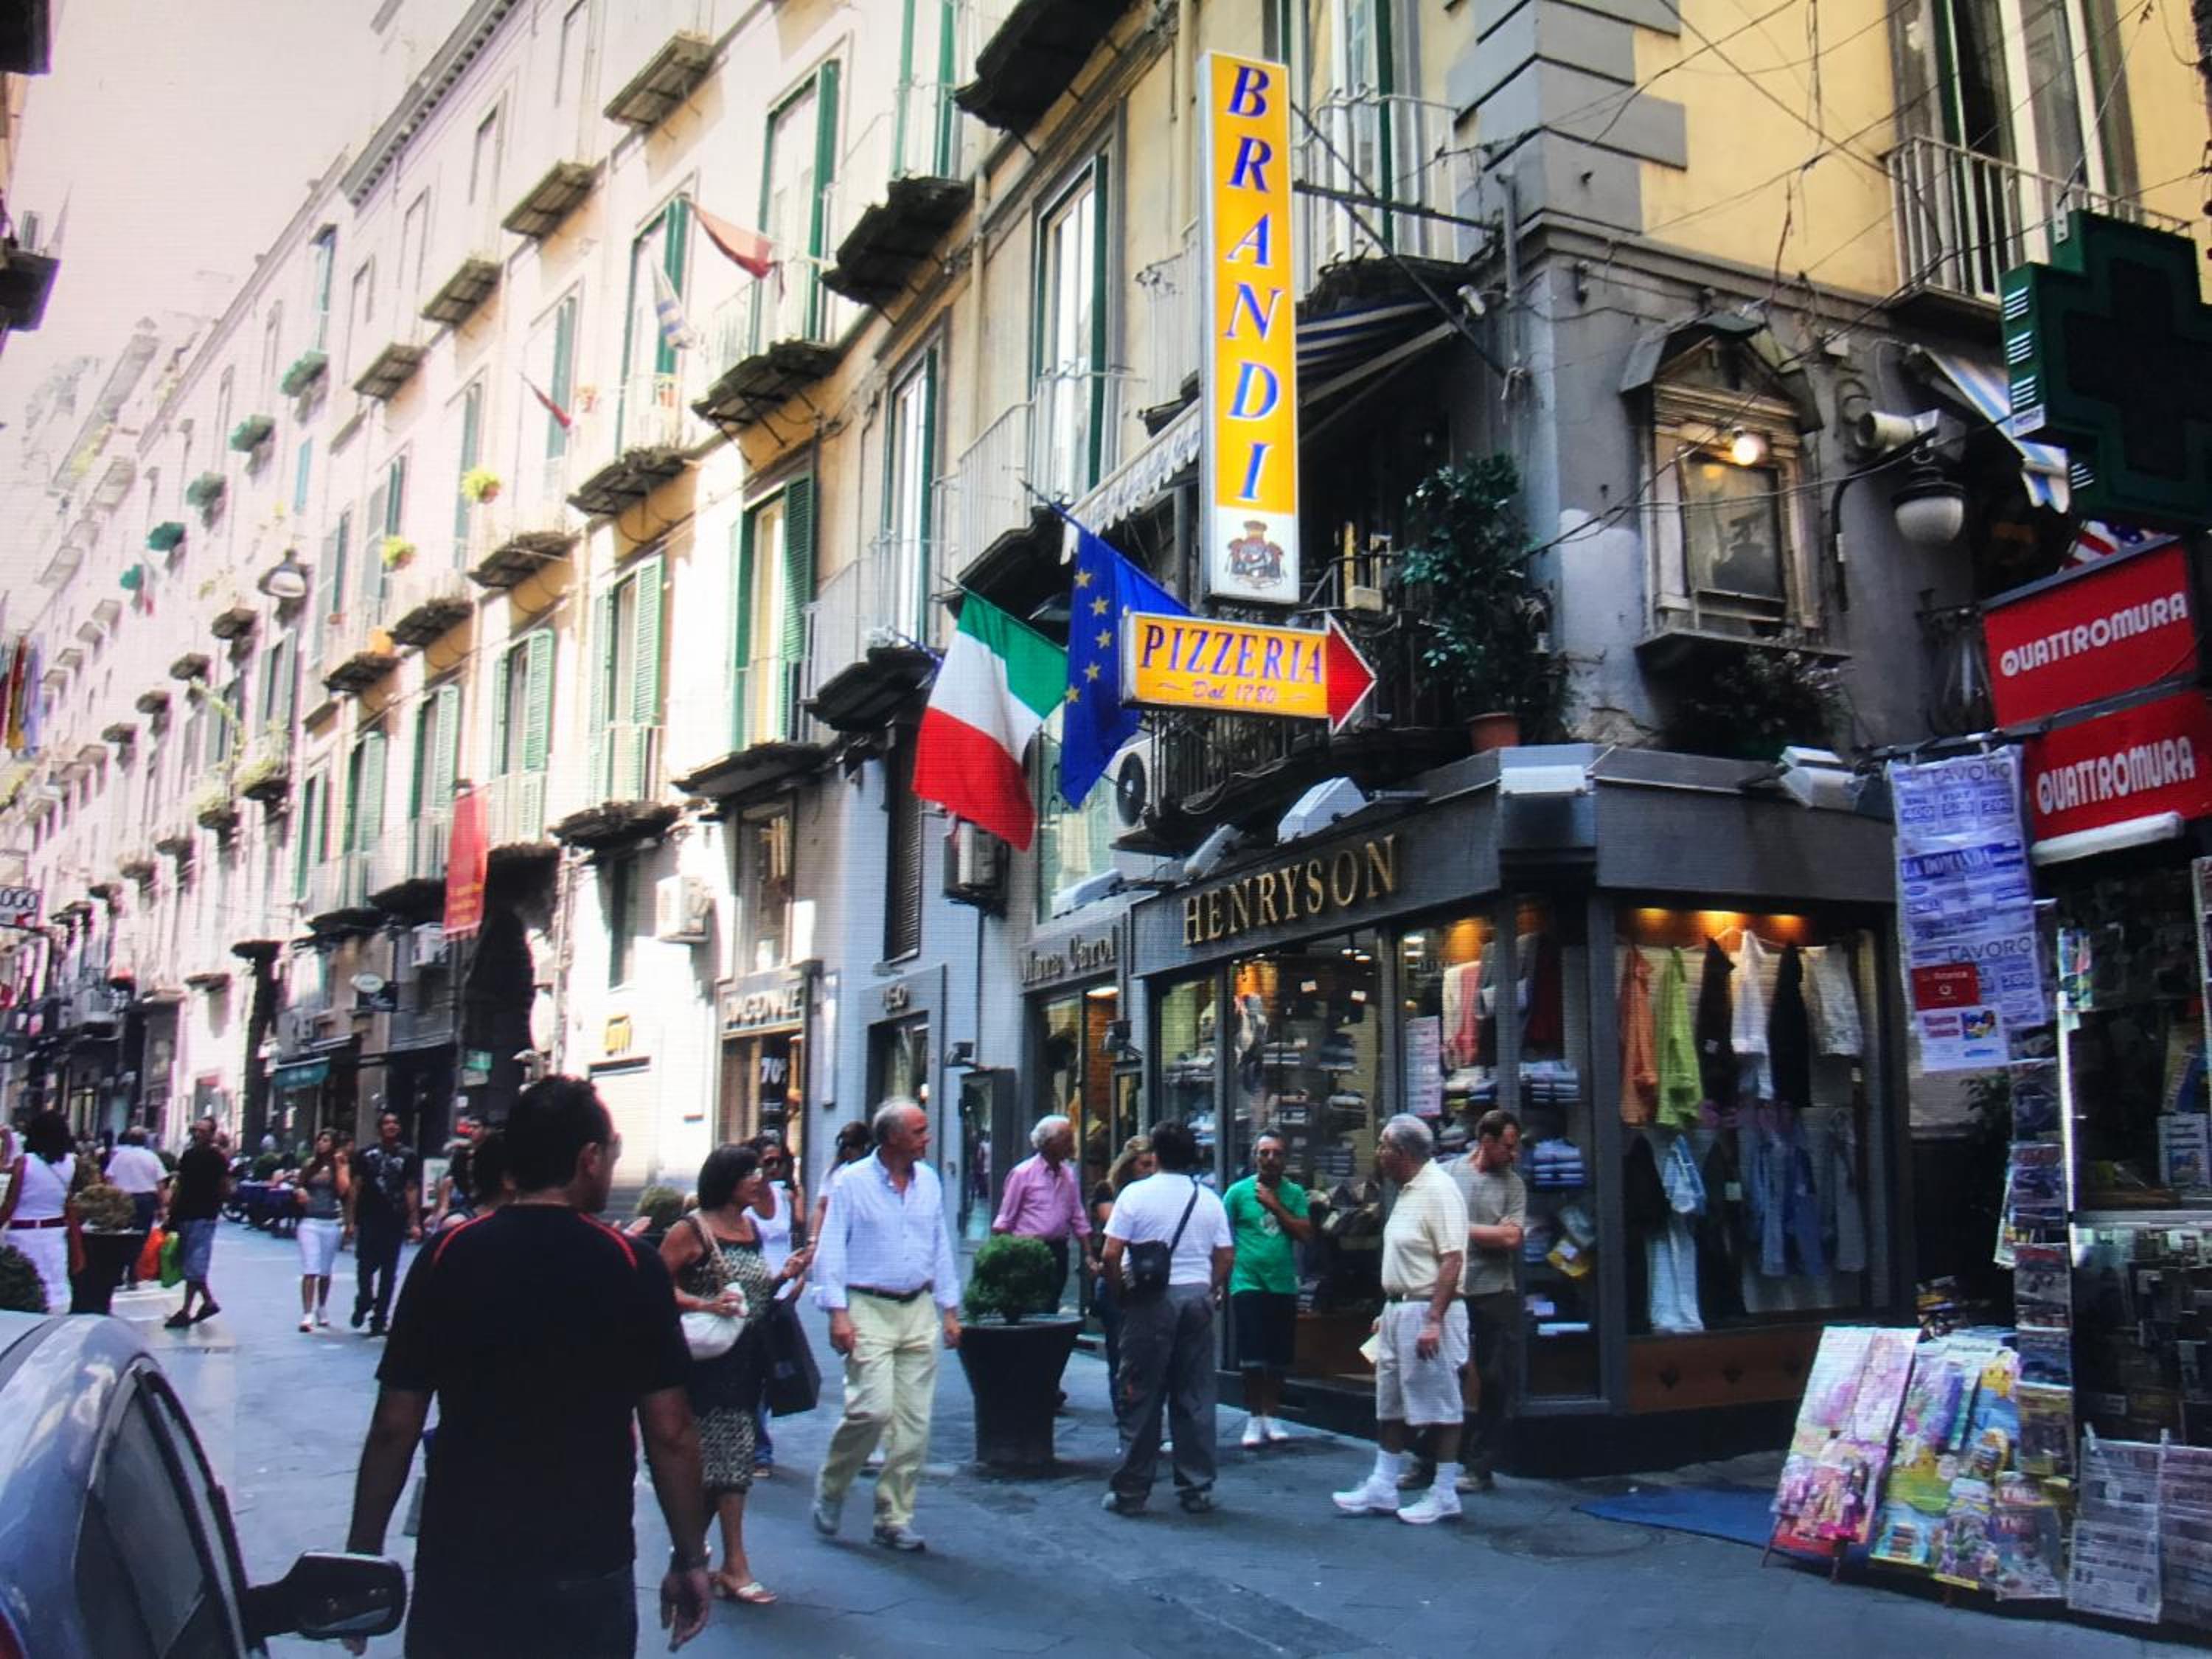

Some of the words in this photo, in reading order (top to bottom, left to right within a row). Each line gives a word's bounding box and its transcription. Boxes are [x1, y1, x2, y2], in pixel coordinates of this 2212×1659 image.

[1224, 64, 1284, 503] BRANDI
[1140, 625, 1323, 684] PIZZERIA
[2000, 592, 2188, 677] QUATTROMURA
[1192, 681, 1227, 700] Dal
[2037, 736, 2196, 815] QUATTROMURA
[1182, 835, 1396, 946] HENRYSON
